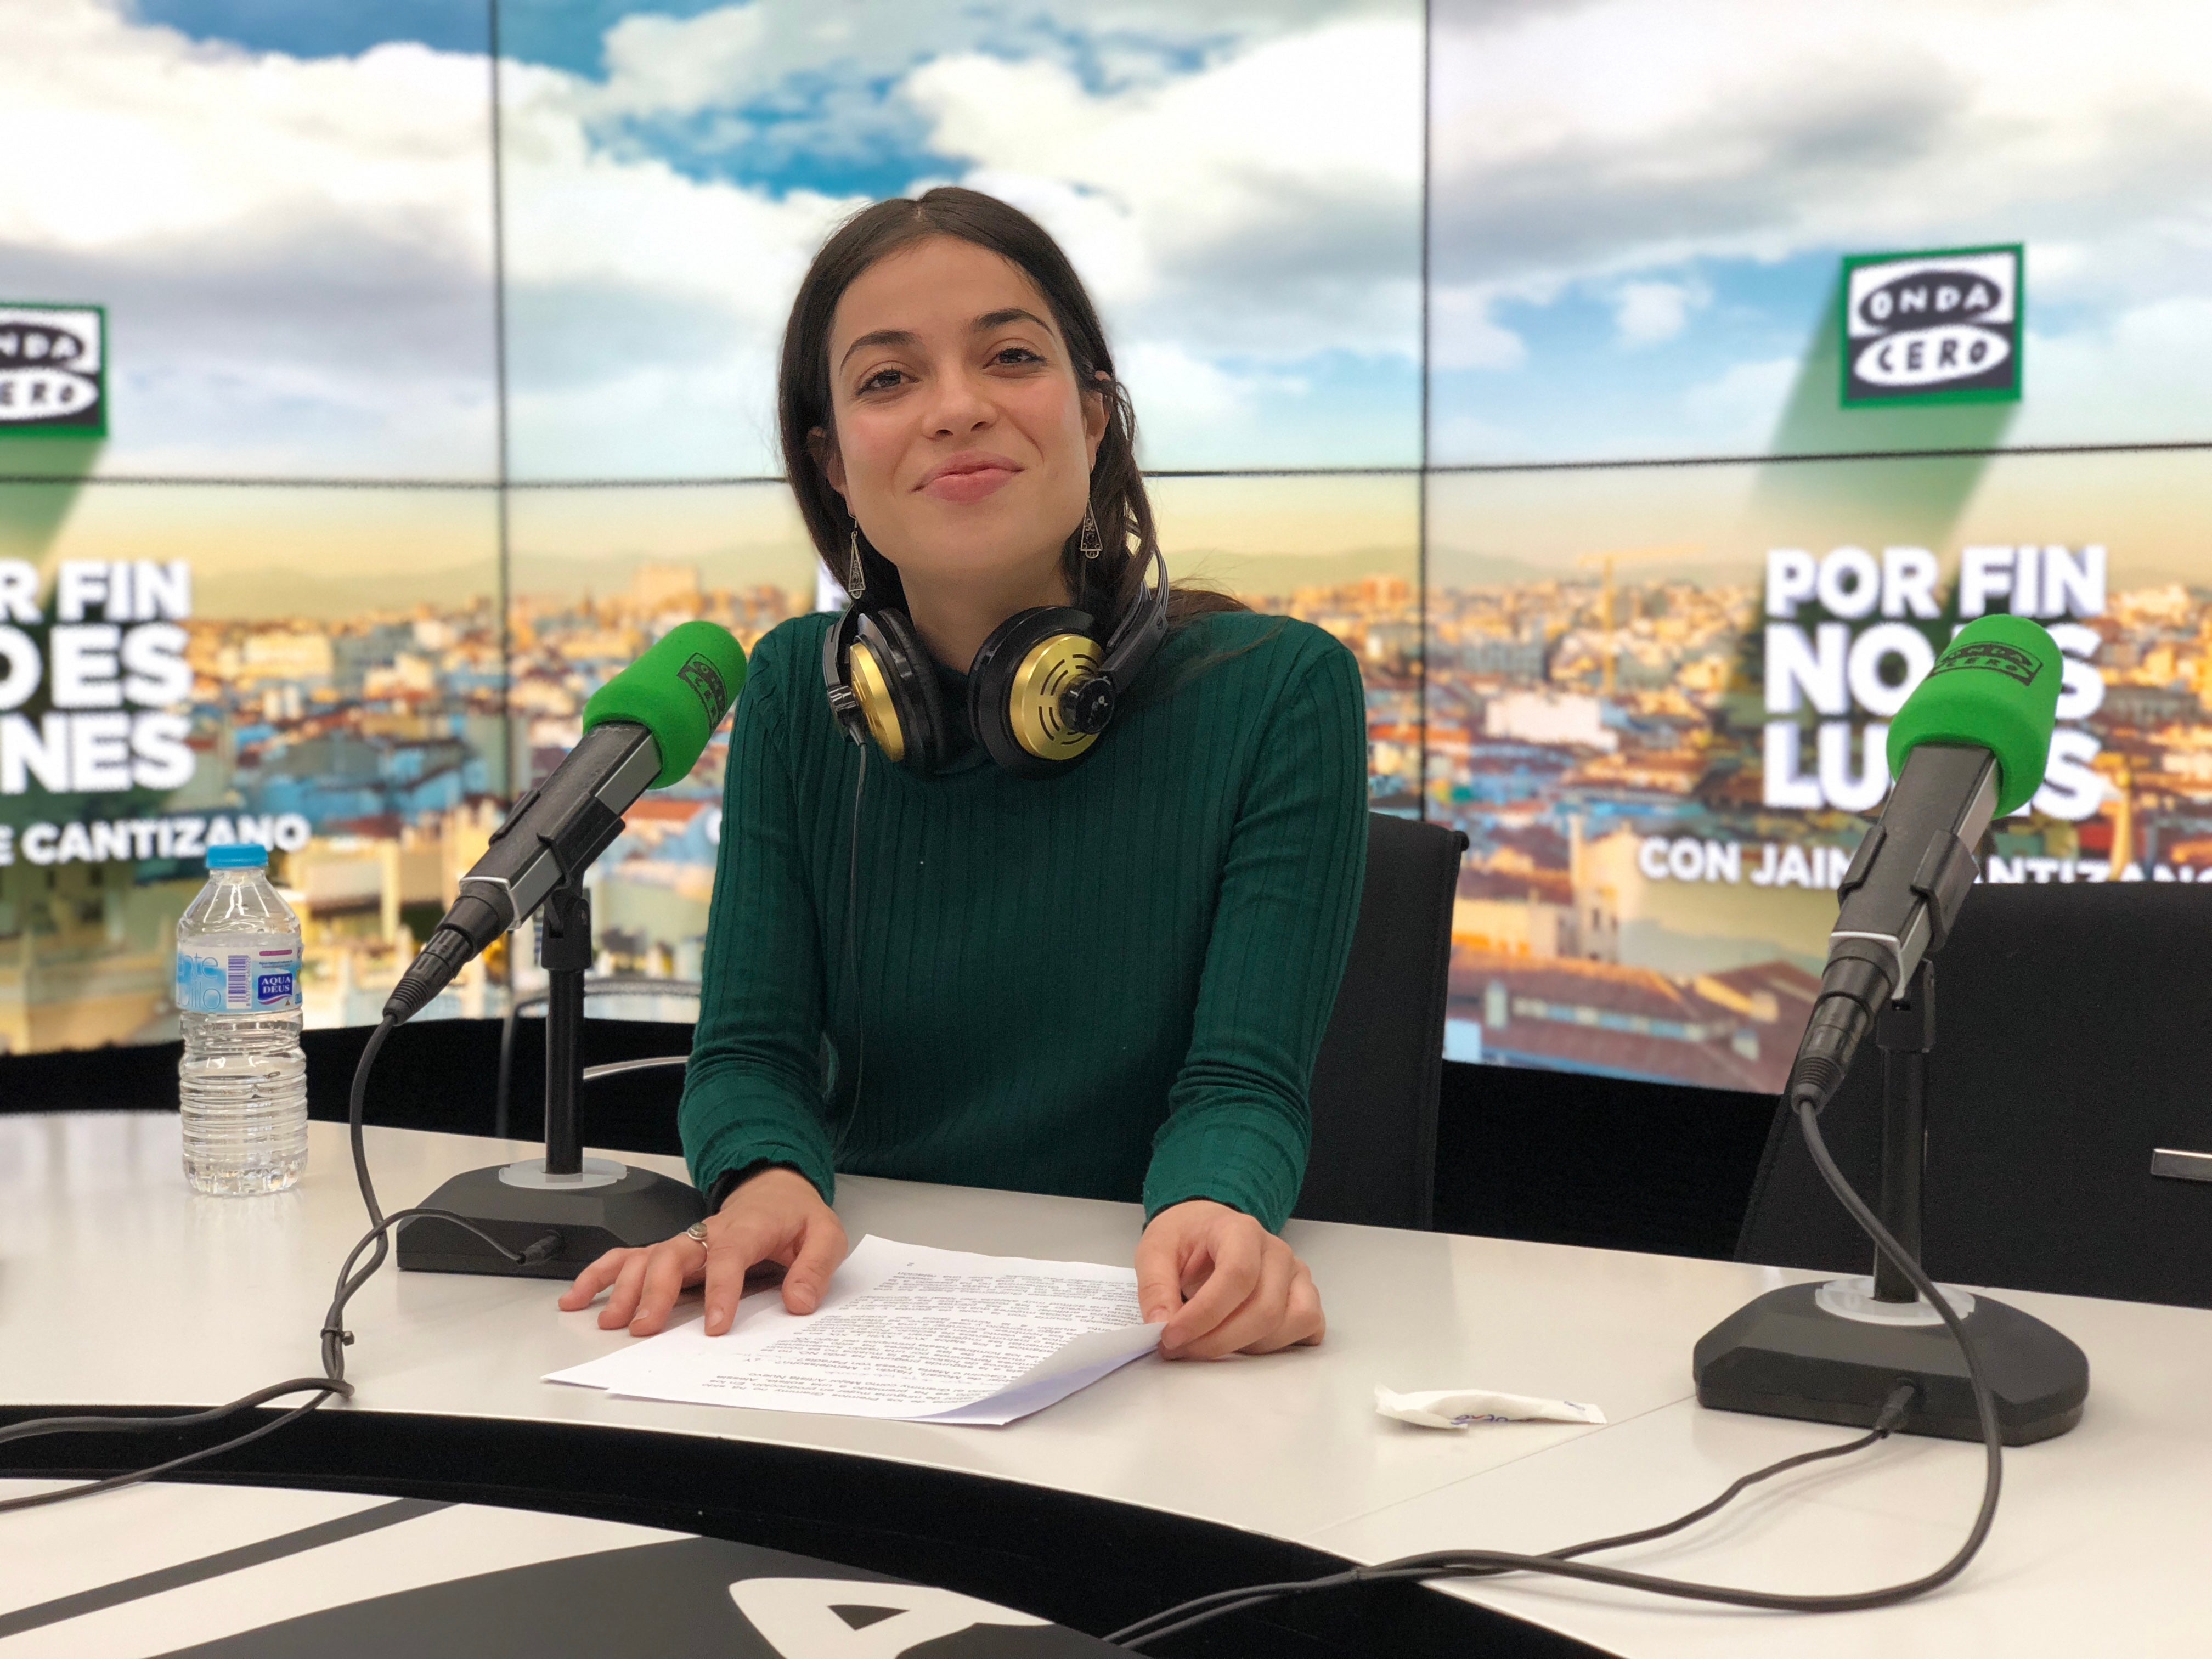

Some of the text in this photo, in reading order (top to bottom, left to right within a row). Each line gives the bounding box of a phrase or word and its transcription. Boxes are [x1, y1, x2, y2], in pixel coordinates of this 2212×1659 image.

[1870, 283, 1990, 320] ONDA
[1877, 338, 1989, 373] CERO
[58, 558, 193, 623] FIN
[1765, 545, 2107, 619] POR FIN
[1763, 622, 1936, 716] NO
[1763, 720, 2104, 821] LUS
[20, 812, 311, 865] CANTIZANO
[1638, 836, 1741, 884] CON
[262, 976, 291, 985] AQUA
[263, 984, 290, 994] DEUS
